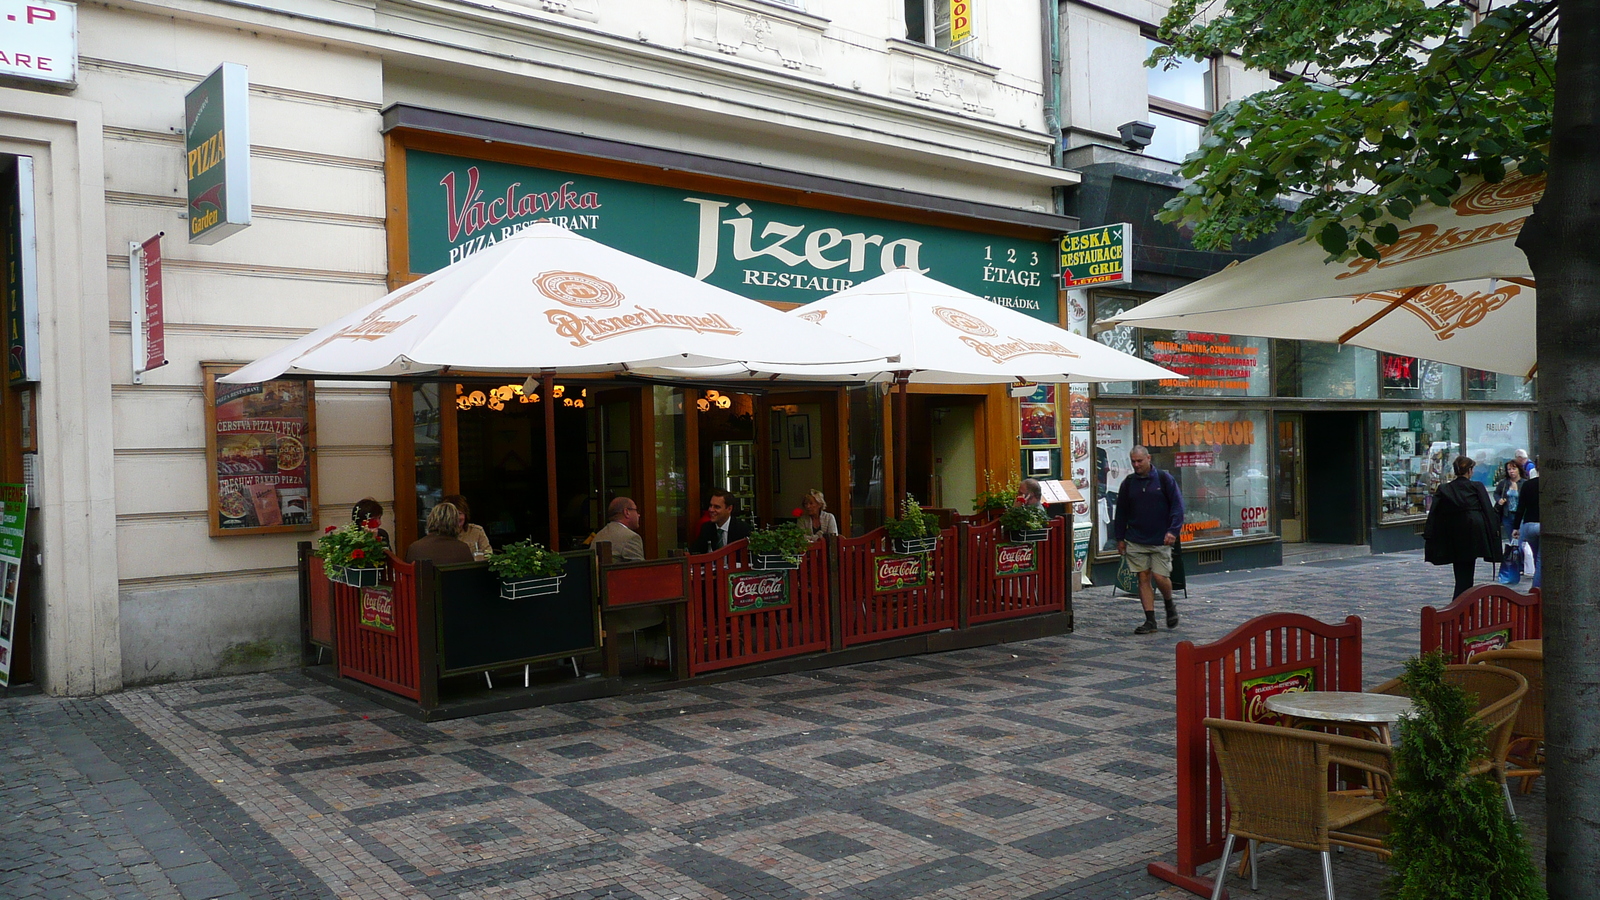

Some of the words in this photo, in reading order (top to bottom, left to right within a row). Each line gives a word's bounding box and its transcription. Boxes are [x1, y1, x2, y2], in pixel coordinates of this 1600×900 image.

[953, 0, 968, 30] OD
[188, 129, 226, 181] PIZZA
[440, 166, 601, 243] Václavka
[191, 208, 218, 234] Garden
[450, 231, 497, 264] PIZZA
[501, 214, 599, 240] RESTURANT
[683, 197, 930, 281] Jizera
[1060, 228, 1111, 252] ČESKÁ
[984, 245, 993, 261] 1
[1007, 248, 1017, 264] 2
[1030, 251, 1039, 266] 3
[1061, 245, 1122, 268] RESTAURACE
[1089, 261, 1122, 275] GRIL
[982, 262, 1041, 287] ÉTAGE
[543, 308, 643, 348] Pilsner
[634, 305, 738, 334] Urquell
[217, 419, 251, 433] ČERSTVÁ
[252, 420, 275, 433] PIZZA
[275, 422, 282, 435] Z
[1142, 420, 1255, 447] REPROCOLOR
[219, 478, 253, 497] FRESHLY
[281, 476, 303, 485] PIZZA
[1240, 506, 1268, 521] COPY
[1241, 520, 1268, 529] centrum
